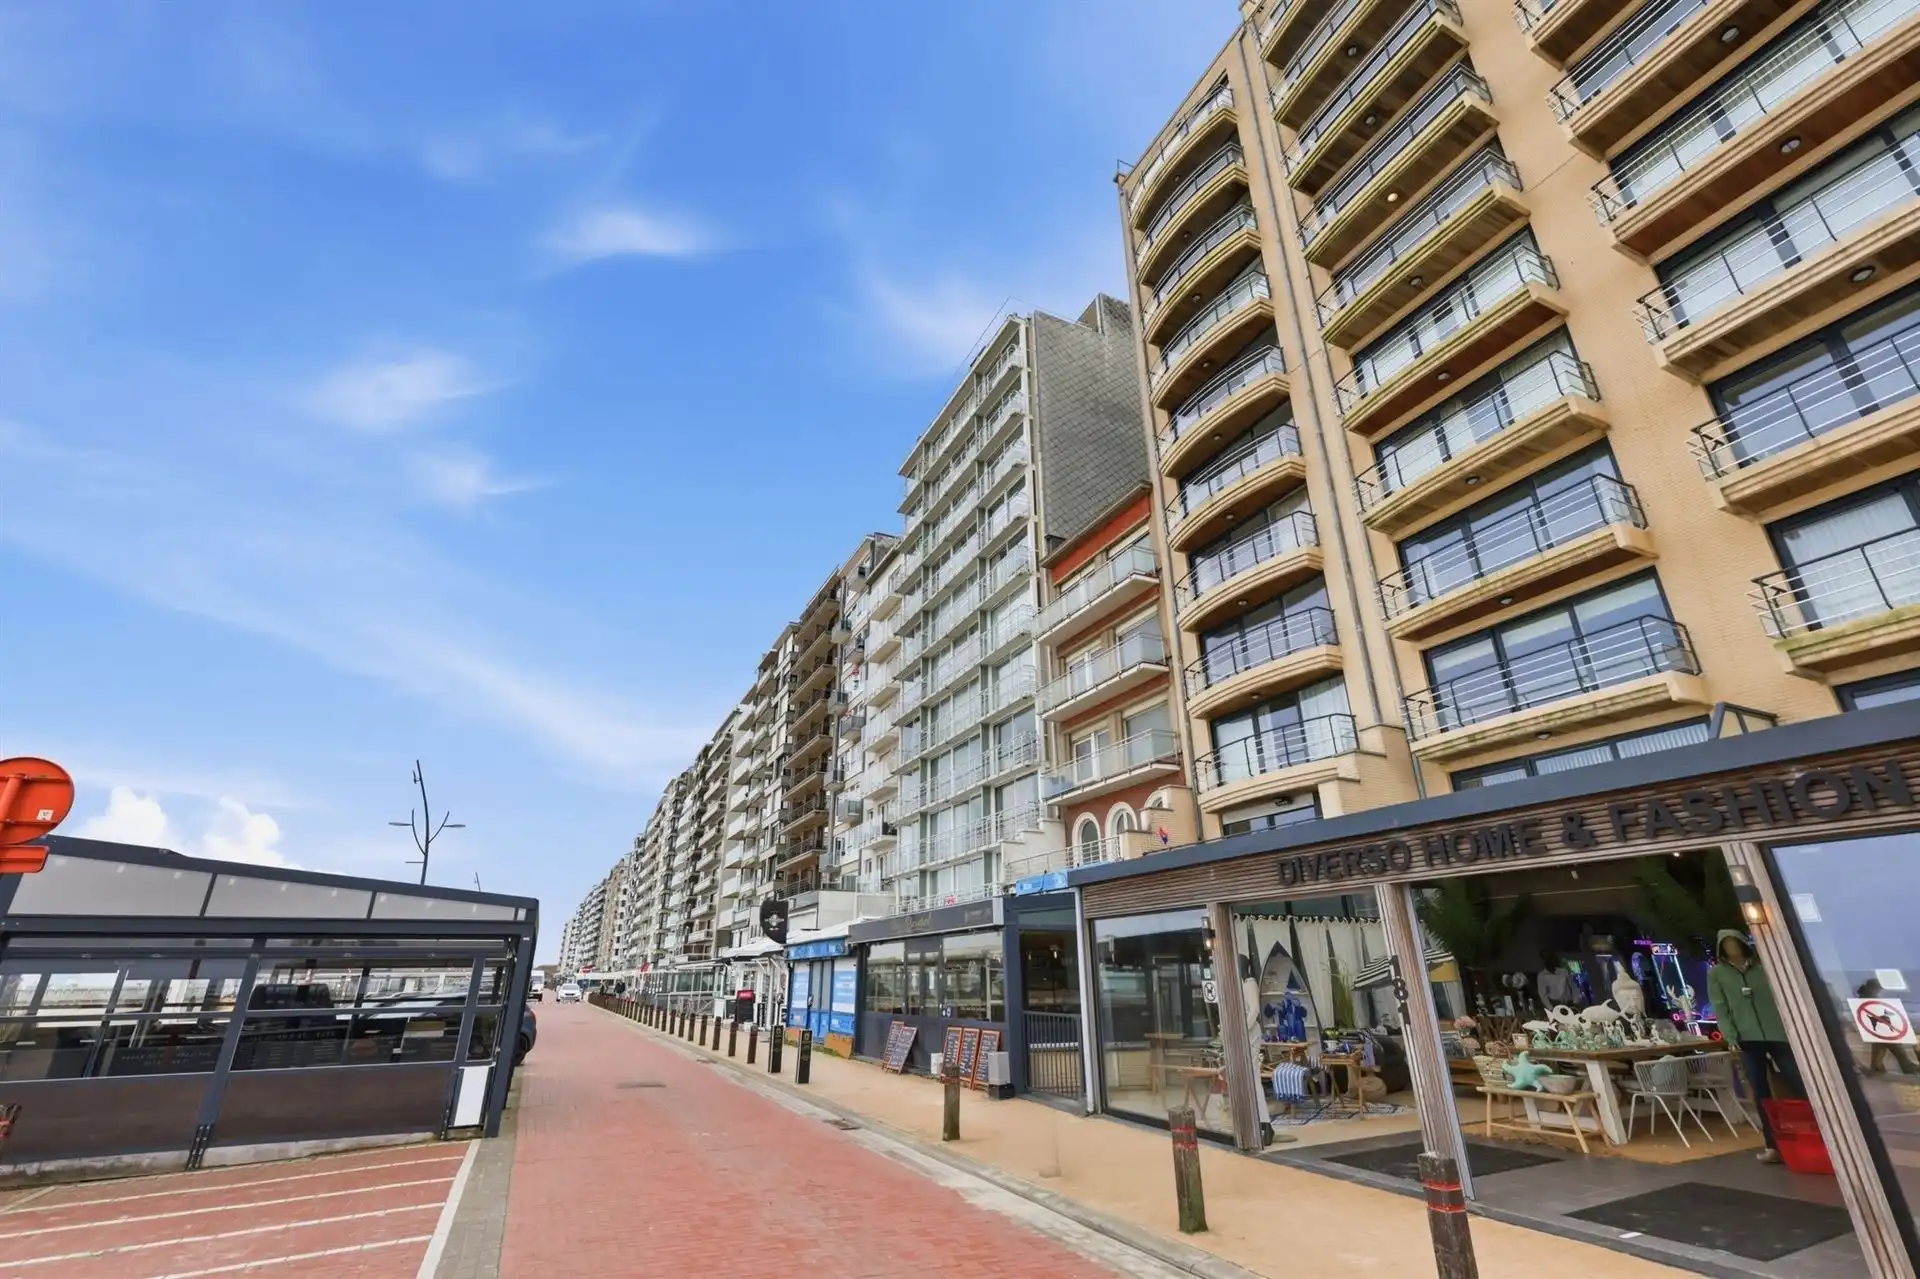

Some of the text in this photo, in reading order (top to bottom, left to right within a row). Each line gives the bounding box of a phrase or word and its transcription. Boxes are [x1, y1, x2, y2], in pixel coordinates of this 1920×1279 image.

[1277, 760, 1916, 886] DIVERSO HOME & FASHION
